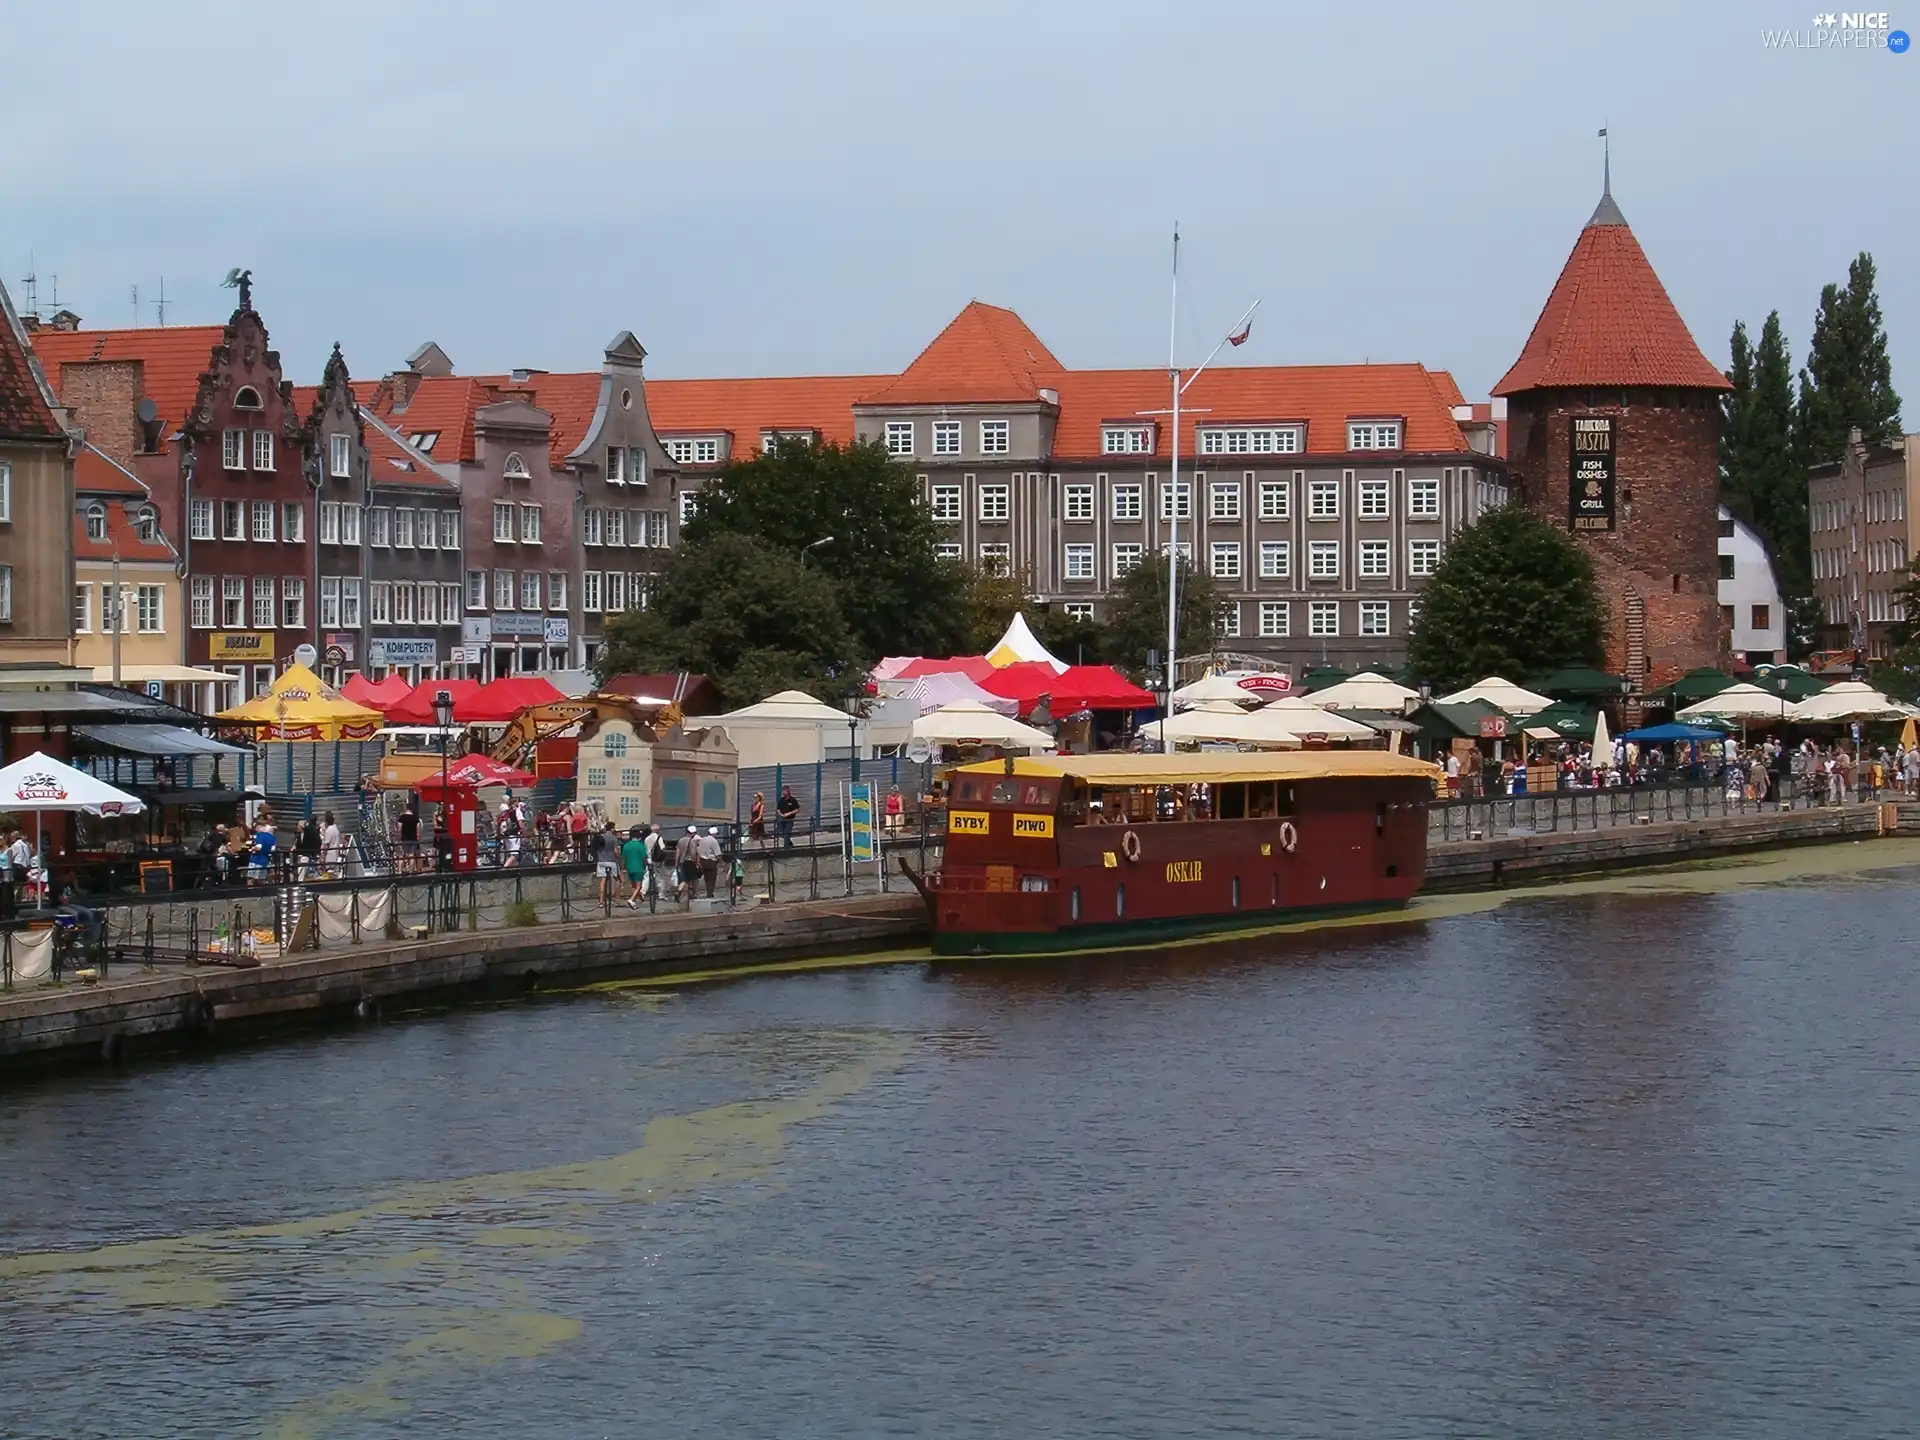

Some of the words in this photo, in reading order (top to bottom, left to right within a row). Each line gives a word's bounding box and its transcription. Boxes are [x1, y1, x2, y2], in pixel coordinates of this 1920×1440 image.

[1576, 432, 1610, 451] BASZTA
[1583, 461, 1602, 469] FISH
[1577, 470, 1608, 479] DISHES
[1580, 500, 1604, 509] GRILL
[386, 642, 434, 653] KOMPUTERY
[954, 816, 988, 831] RYBY,
[1016, 819, 1046, 832] PIWO
[1166, 860, 1202, 883] OSKAR
